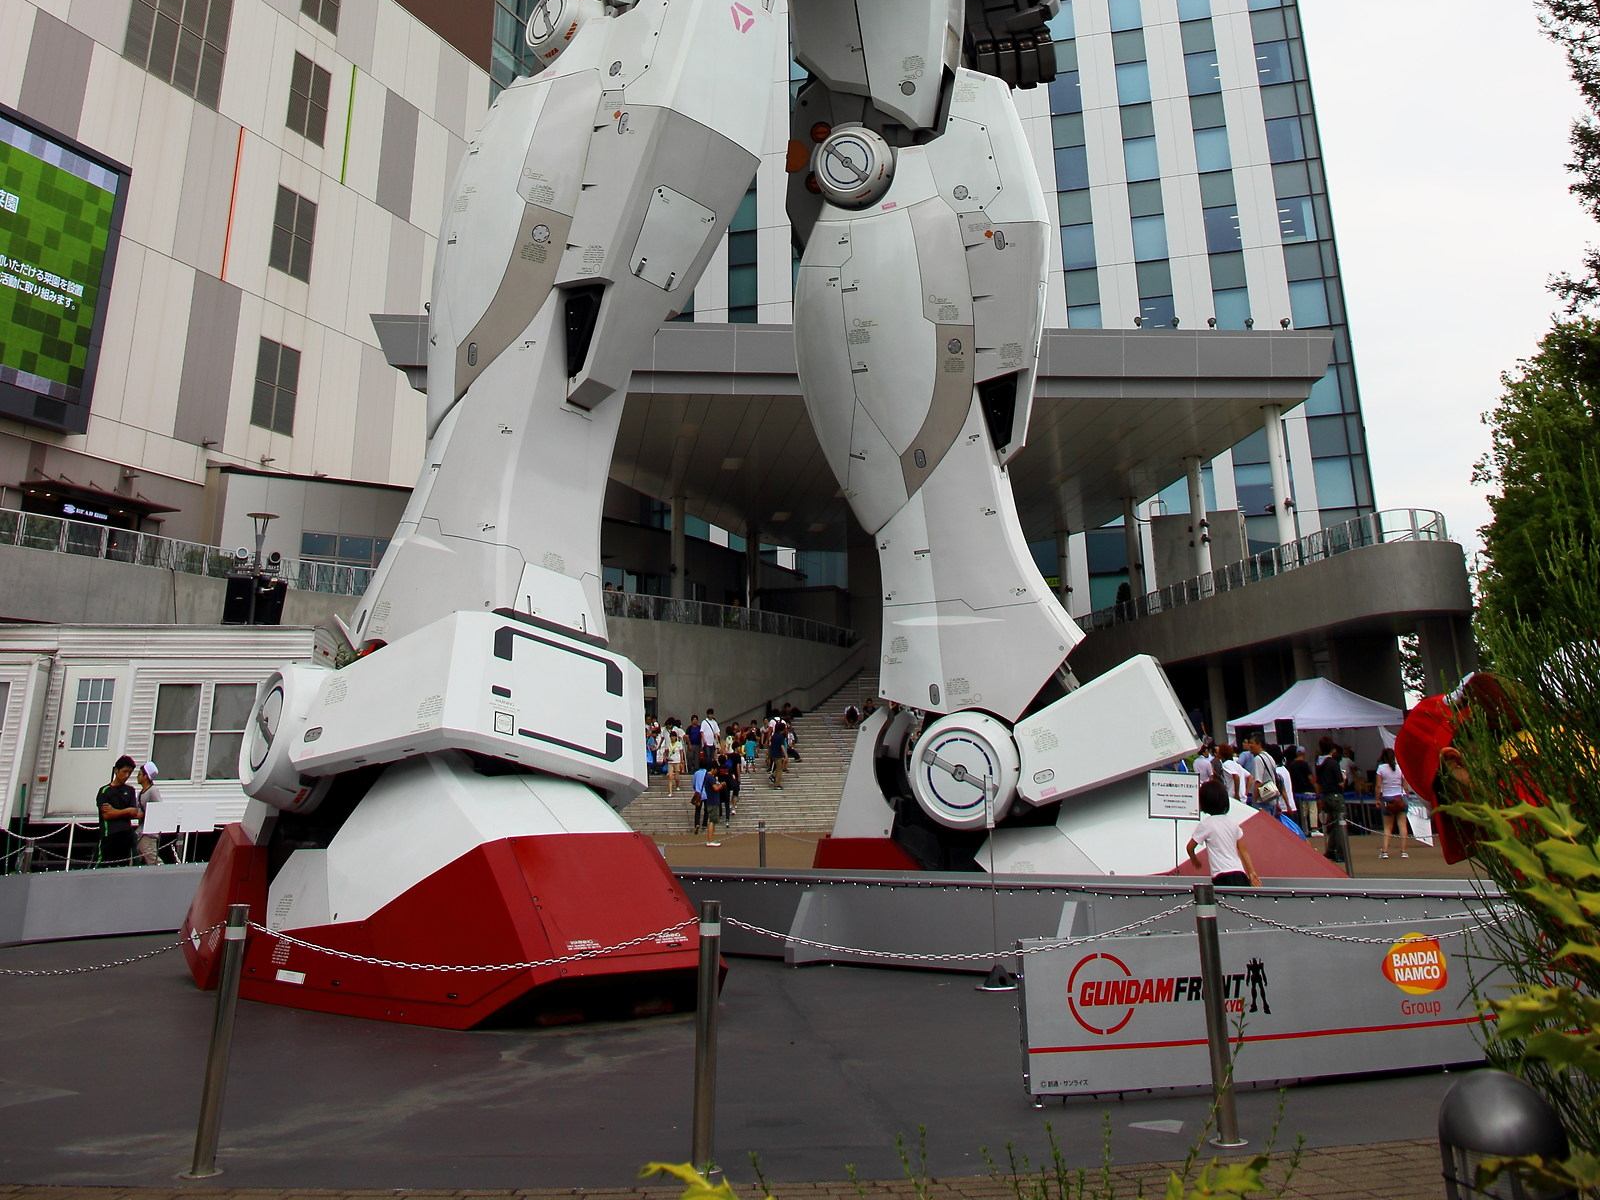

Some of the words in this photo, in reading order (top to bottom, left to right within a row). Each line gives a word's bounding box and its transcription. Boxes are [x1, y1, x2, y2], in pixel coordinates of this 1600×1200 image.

[1392, 950, 1438, 967] BANDAI
[1394, 965, 1440, 982] NAMCO
[1401, 999, 1441, 1016] Group
